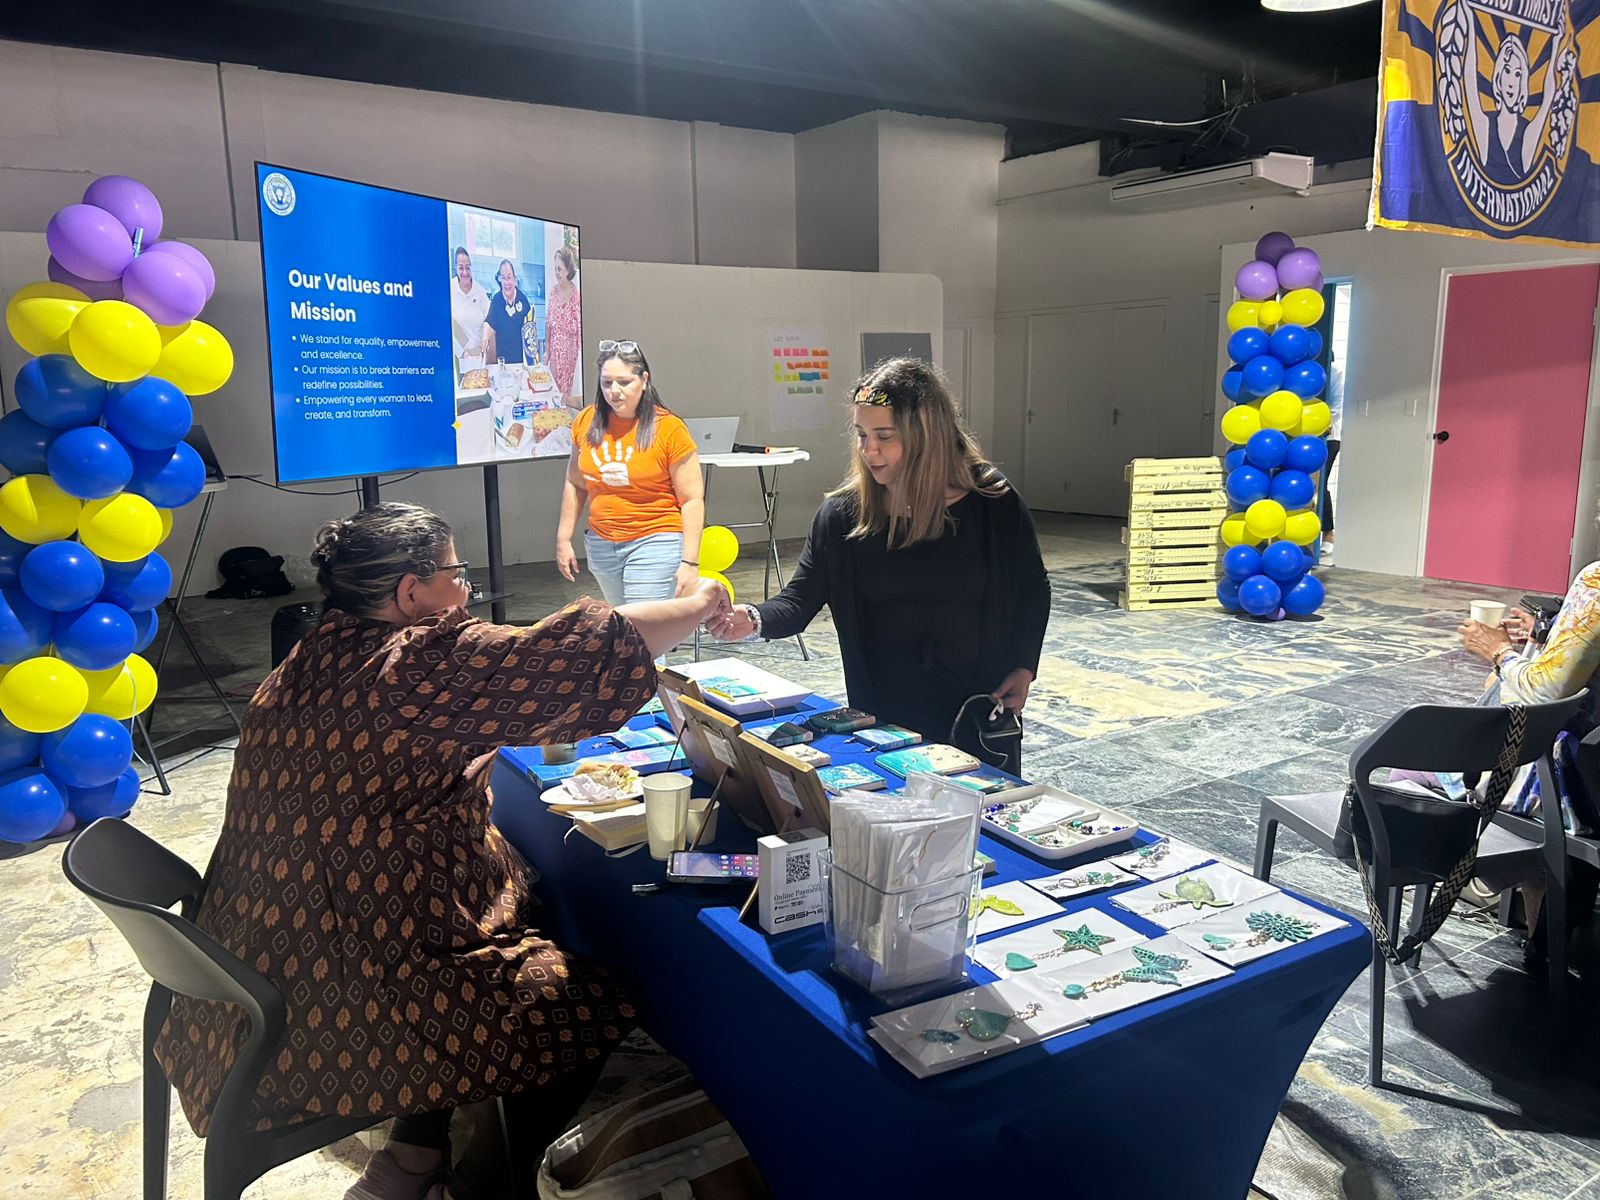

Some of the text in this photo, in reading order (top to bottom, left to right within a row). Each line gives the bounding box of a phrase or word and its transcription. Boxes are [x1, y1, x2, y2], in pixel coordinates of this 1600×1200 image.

[1457, 150, 1554, 223] INTERNATIONAL
[288, 269, 413, 298] Our Values and
[290, 300, 357, 323] Mission
[300, 334, 441, 349] We stand for equality, empowerment,
[301, 350, 364, 360] and excellence.
[302, 364, 435, 375] Our mission is to break barriers and
[303, 380, 384, 391] redefine possibilities.
[304, 393, 433, 407] Empowering every woman to lead,
[304, 408, 392, 421] create, and transform.
[774, 892, 795, 901] Online
